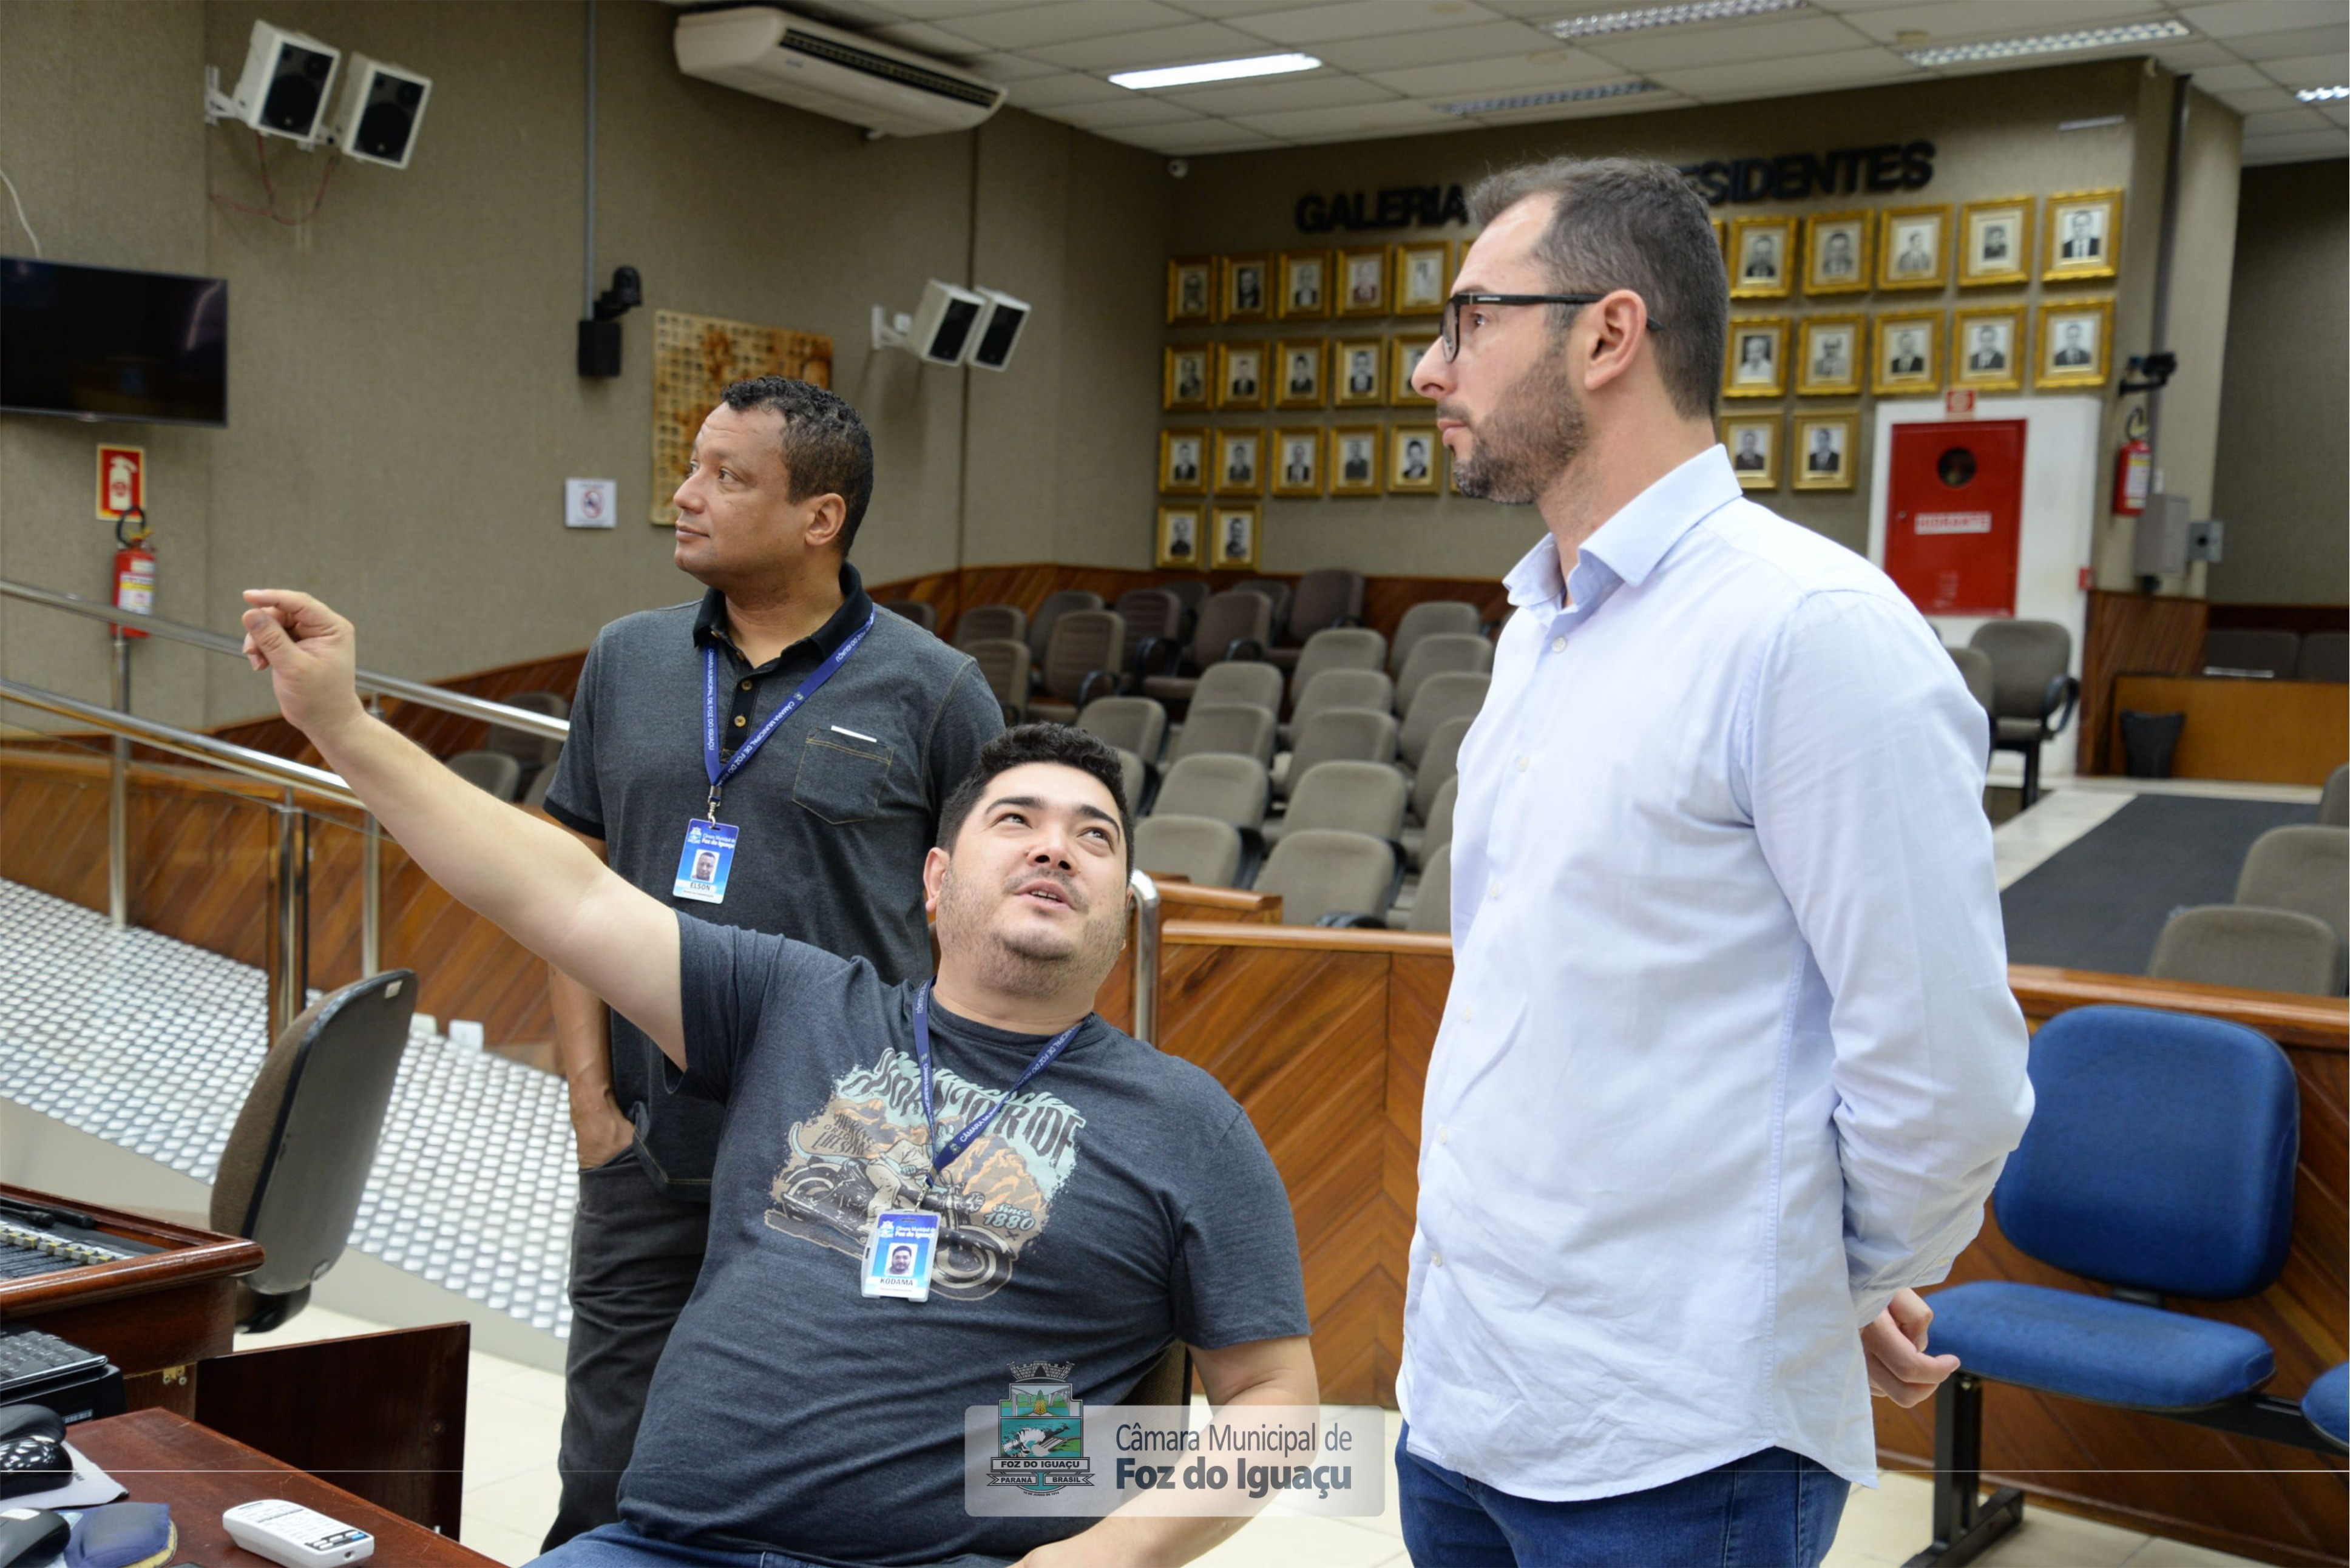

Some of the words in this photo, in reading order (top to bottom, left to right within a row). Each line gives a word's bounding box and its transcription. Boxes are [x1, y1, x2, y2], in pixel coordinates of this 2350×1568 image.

[1295, 183, 1469, 233] GALERIA
[1679, 140, 1937, 204] SIDENTES
[708, 718, 714, 728] DO
[750, 720, 777, 746] MUNICIPAL
[743, 745, 753, 754] DE
[734, 752, 747, 766] FOZ
[728, 764, 737, 774] DO
[690, 882, 711, 891] ELSON
[1046, 1047, 1056, 1056] DE
[1038, 1053, 1049, 1066] FOZ
[1032, 1064, 1041, 1073] DO
[992, 1203, 1032, 1217] Since
[983, 1213, 1035, 1231] 1880
[880, 1277, 913, 1286] KODAMA
